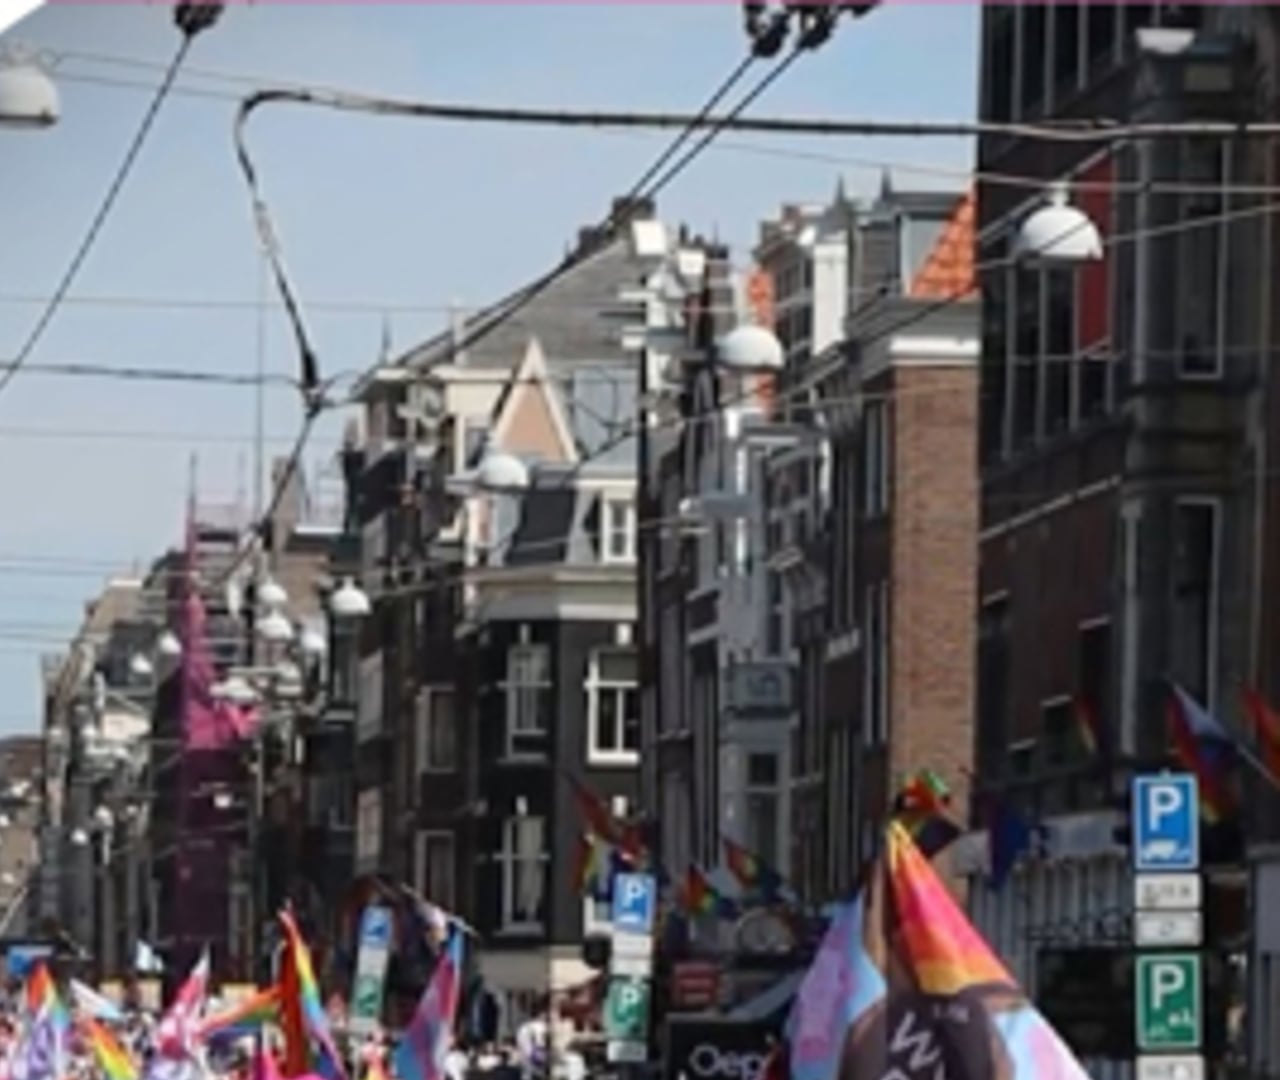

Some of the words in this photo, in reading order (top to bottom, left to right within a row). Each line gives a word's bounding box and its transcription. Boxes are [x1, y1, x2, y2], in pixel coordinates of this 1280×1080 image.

[1147, 784, 1183, 832] P
[622, 877, 646, 909] P
[1150, 963, 1185, 1011] P
